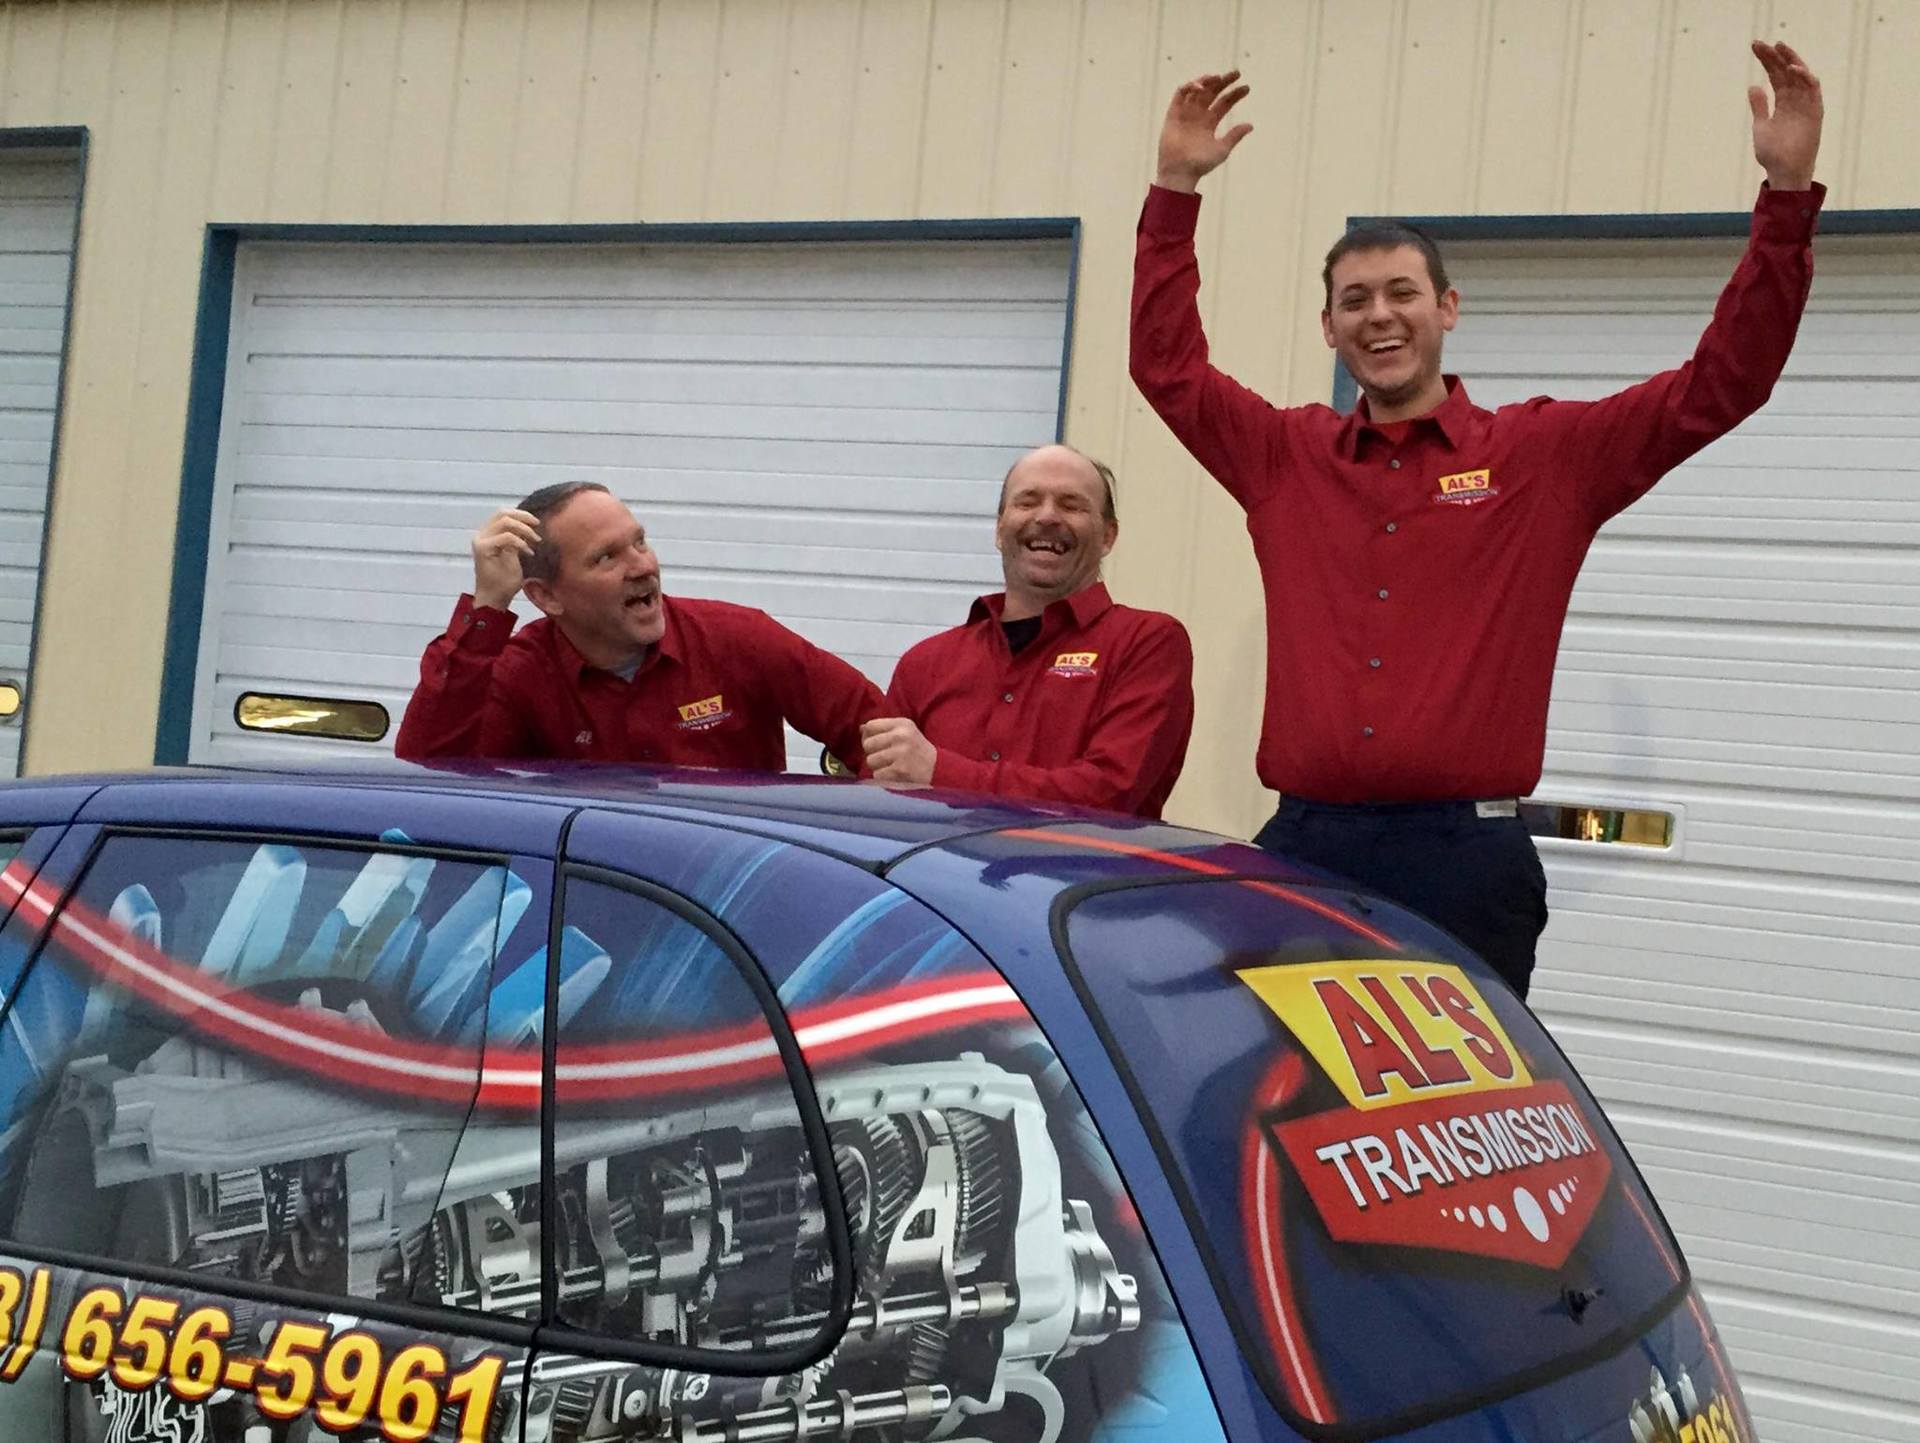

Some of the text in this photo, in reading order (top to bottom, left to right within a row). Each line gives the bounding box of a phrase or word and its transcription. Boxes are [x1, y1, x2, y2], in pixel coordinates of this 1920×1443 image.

[1447, 475, 1485, 491] AL'S
[1060, 656, 1090, 665] AL'S
[687, 702, 719, 718] AL'S
[1313, 975, 1514, 1098] AL'S
[1316, 1103, 1596, 1208] TRANSMISSION
[63, 1286, 503, 1443] 656-5961
